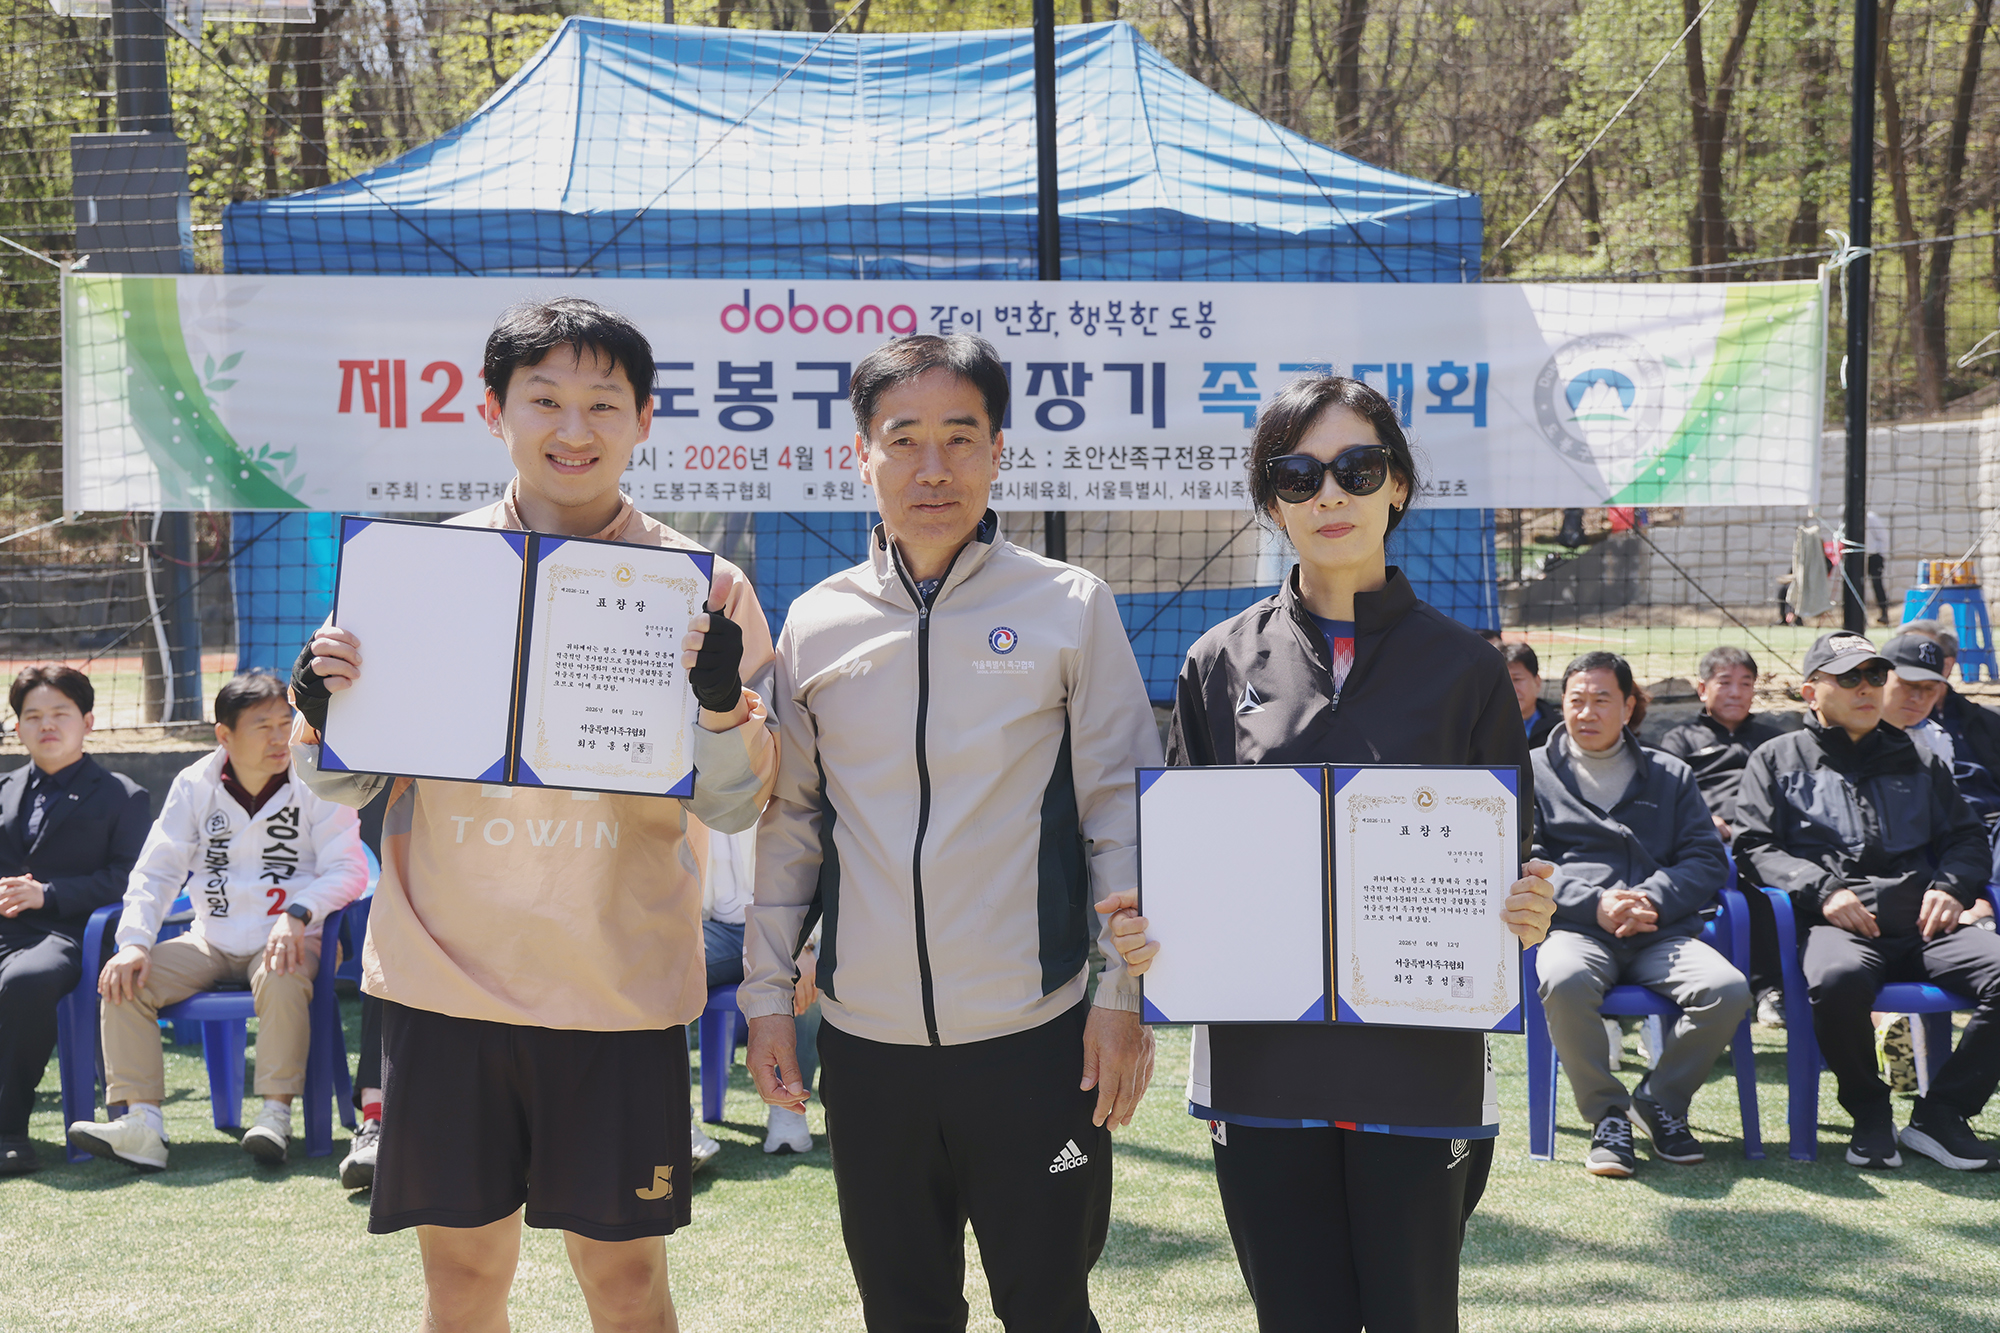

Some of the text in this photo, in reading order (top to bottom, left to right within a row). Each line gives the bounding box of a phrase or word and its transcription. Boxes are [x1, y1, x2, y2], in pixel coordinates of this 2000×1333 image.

[930, 300, 1216, 339] 같이 변화, 행복한 도봉
[338, 359, 486, 428] 제2
[1199, 361, 1489, 428] 족대회
[684, 445, 768, 470] 2026년
[777, 445, 813, 470] 4월
[824, 445, 853, 470] 12
[999, 446, 1036, 470] 장소
[385, 482, 418, 500] 주최
[440, 482, 506, 500] 도봉구체
[653, 482, 771, 501] 도봉구족구협회
[822, 481, 854, 500] 후원
[990, 480, 1078, 500] 별시체육회,
[1085, 480, 1173, 500] 서울특별시,
[1181, 480, 1246, 500] 서울시족
[1420, 480, 1468, 497] 스포츠
[580, 724, 646, 737] 서울특별시족구협회
[450, 815, 619, 849] TOWIN
[266, 888, 287, 916] 2
[1395, 958, 1464, 970] 서울특별시족구협회
[1049, 1154, 1089, 1174] adidas
